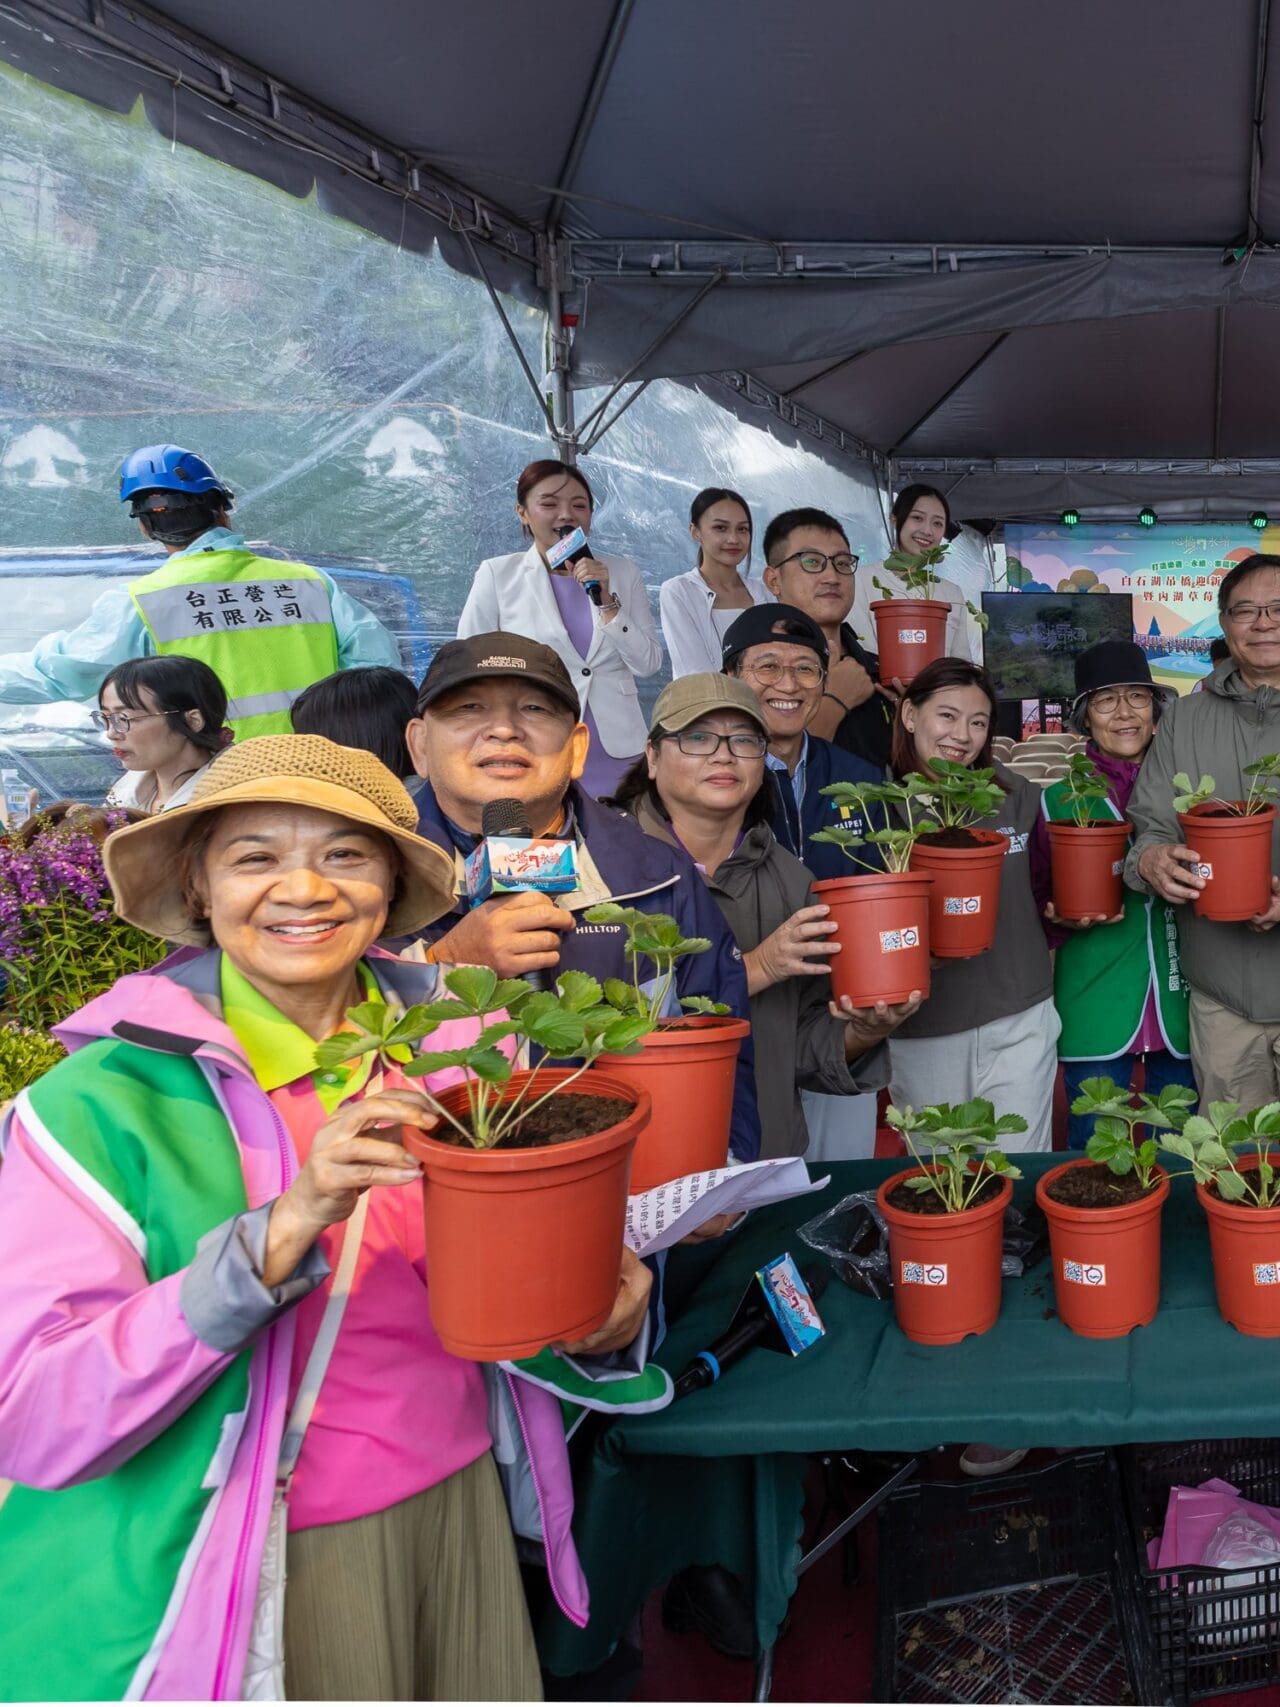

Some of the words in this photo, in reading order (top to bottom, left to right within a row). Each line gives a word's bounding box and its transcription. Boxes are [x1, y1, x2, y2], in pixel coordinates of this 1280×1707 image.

[186, 583, 297, 607] 台正營造
[193, 602, 303, 629] 有限公司
[576, 924, 621, 935] HILLTOP
